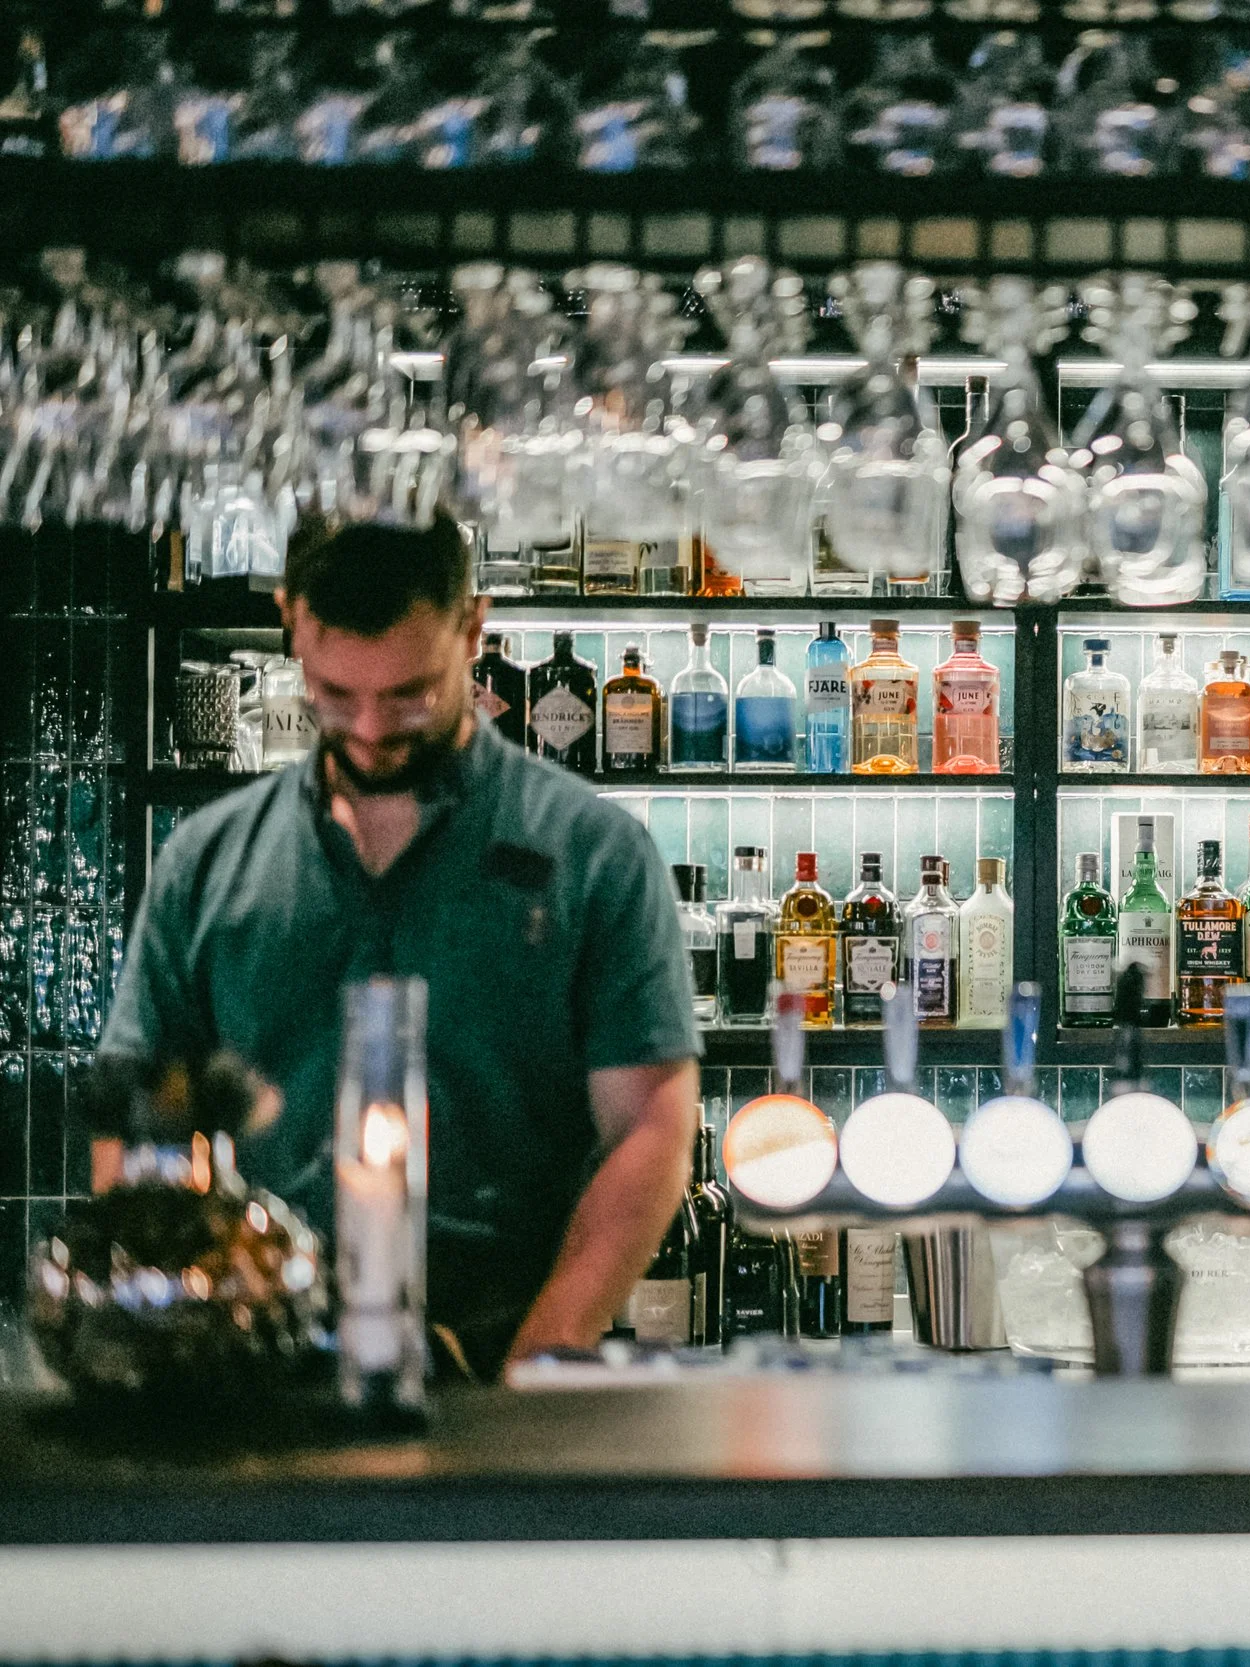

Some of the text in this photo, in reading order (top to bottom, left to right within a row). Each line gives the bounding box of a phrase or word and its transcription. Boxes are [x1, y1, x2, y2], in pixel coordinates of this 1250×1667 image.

[808, 680, 847, 694] FJÄRE
[878, 691, 899, 701] JUNE
[957, 692, 979, 701] JUNE
[1182, 921, 1237, 932] TULLAMORE
[1121, 936, 1171, 946] LAPHROAI
